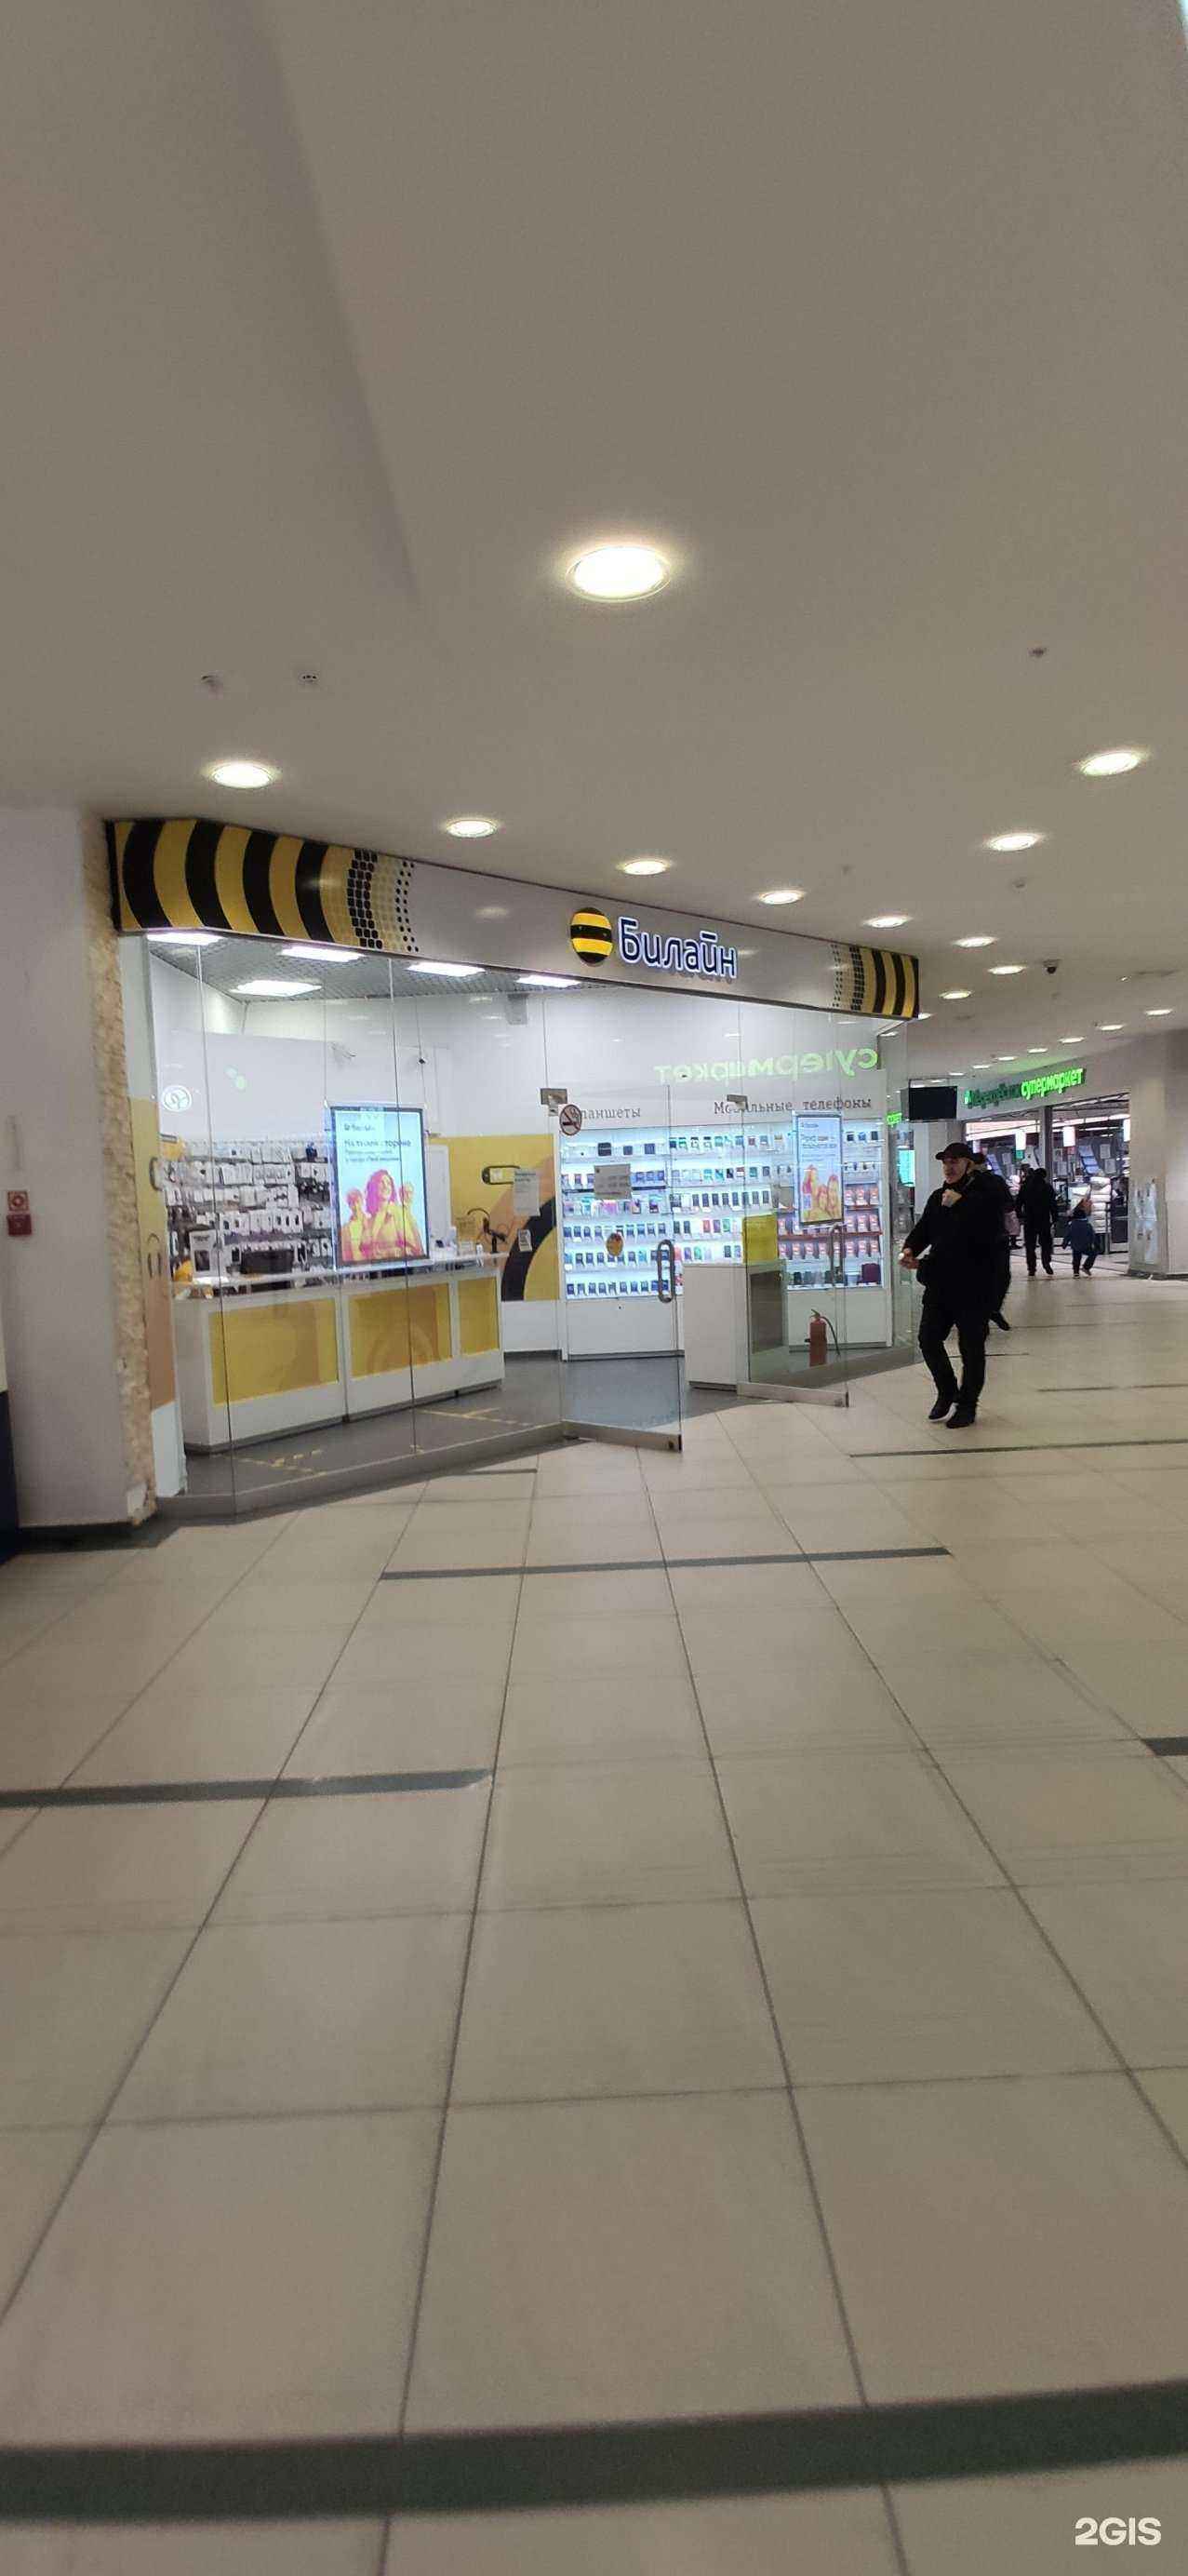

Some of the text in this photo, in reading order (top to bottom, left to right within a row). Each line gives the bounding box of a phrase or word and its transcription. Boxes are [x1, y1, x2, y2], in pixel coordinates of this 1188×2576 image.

[618, 916, 738, 978] Билайн
[1021, 1068, 1084, 1101] супермаркет
[571, 1107, 641, 1120] ланшеты
[714, 1094, 873, 1115] Мольные телефоны
